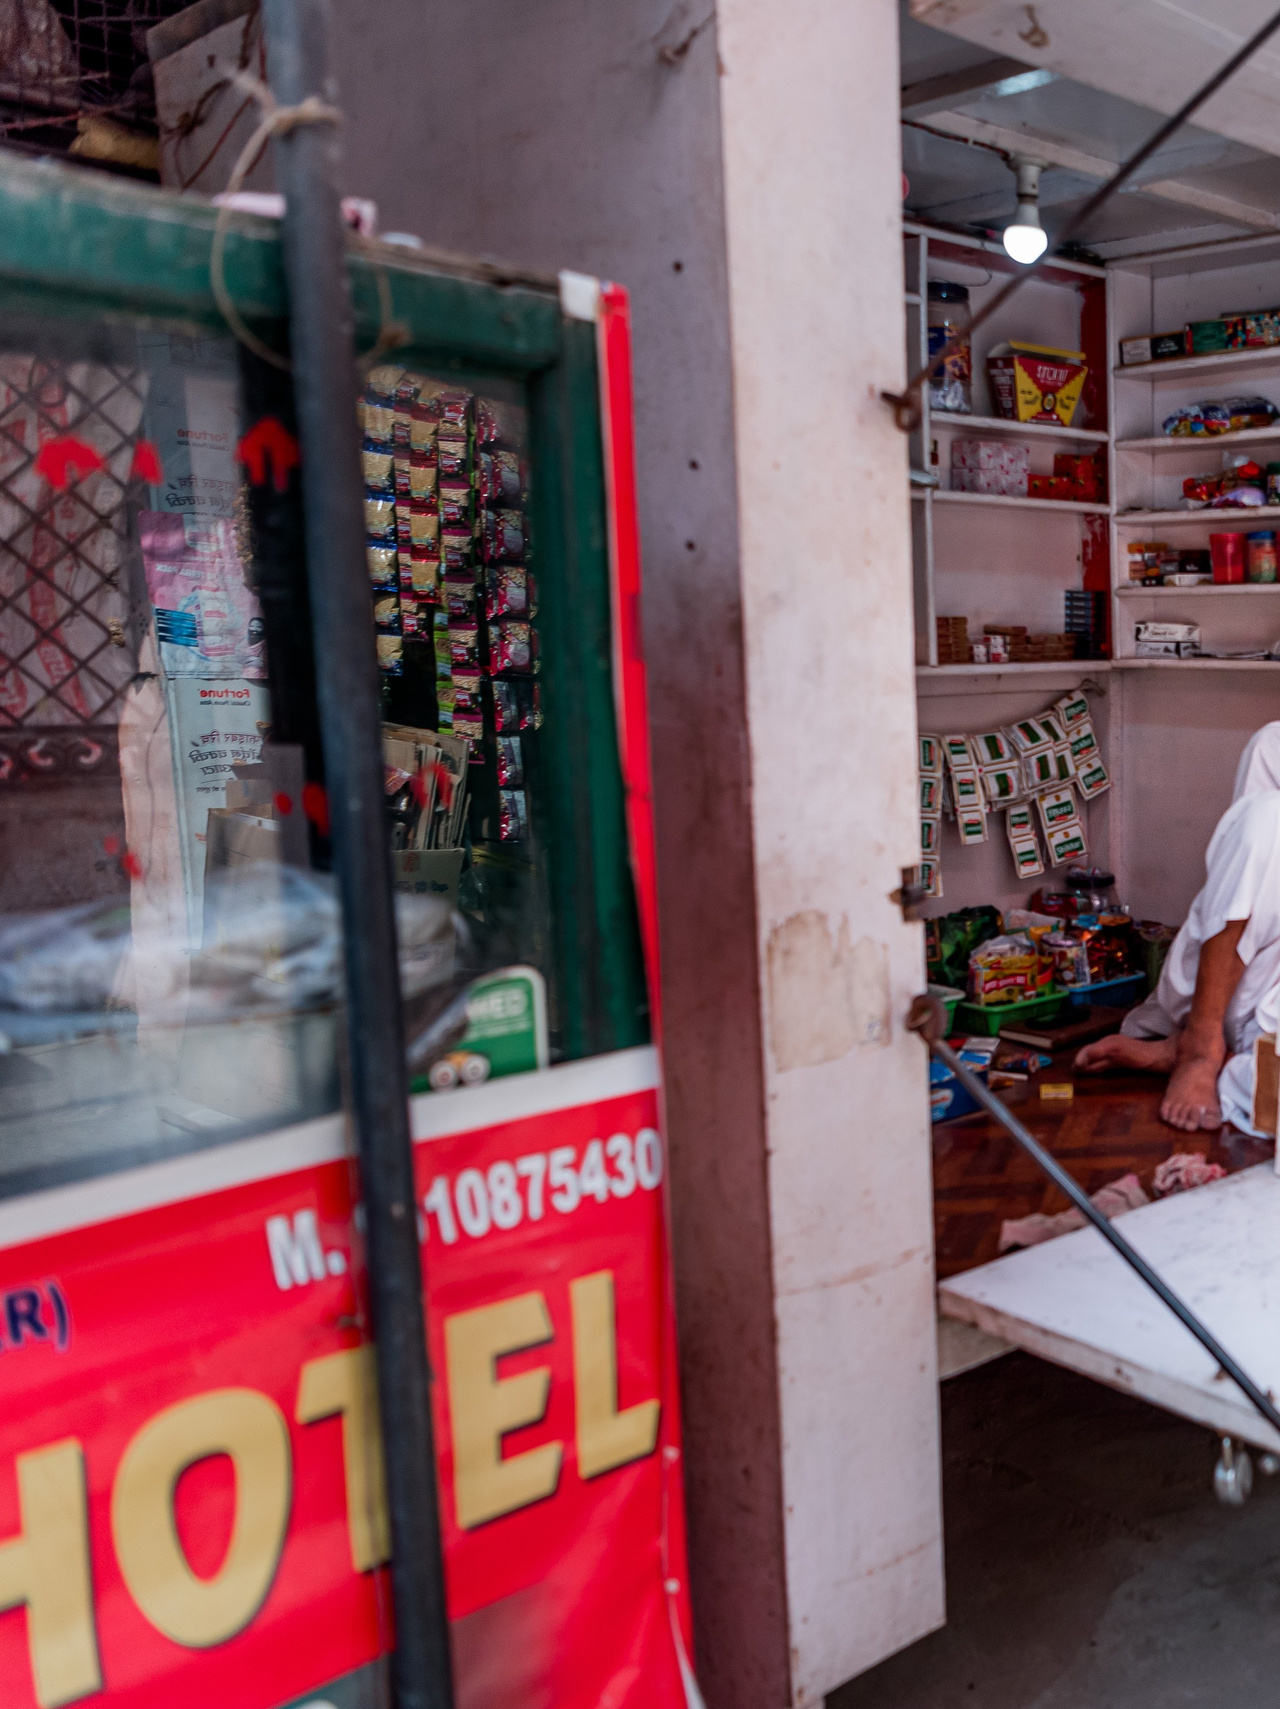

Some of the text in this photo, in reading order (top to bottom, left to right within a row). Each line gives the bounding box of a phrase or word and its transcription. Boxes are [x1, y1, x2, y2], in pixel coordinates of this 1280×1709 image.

[265, 1127, 663, 1291] M. 10875430
[0, 1276, 70, 1354] R)
